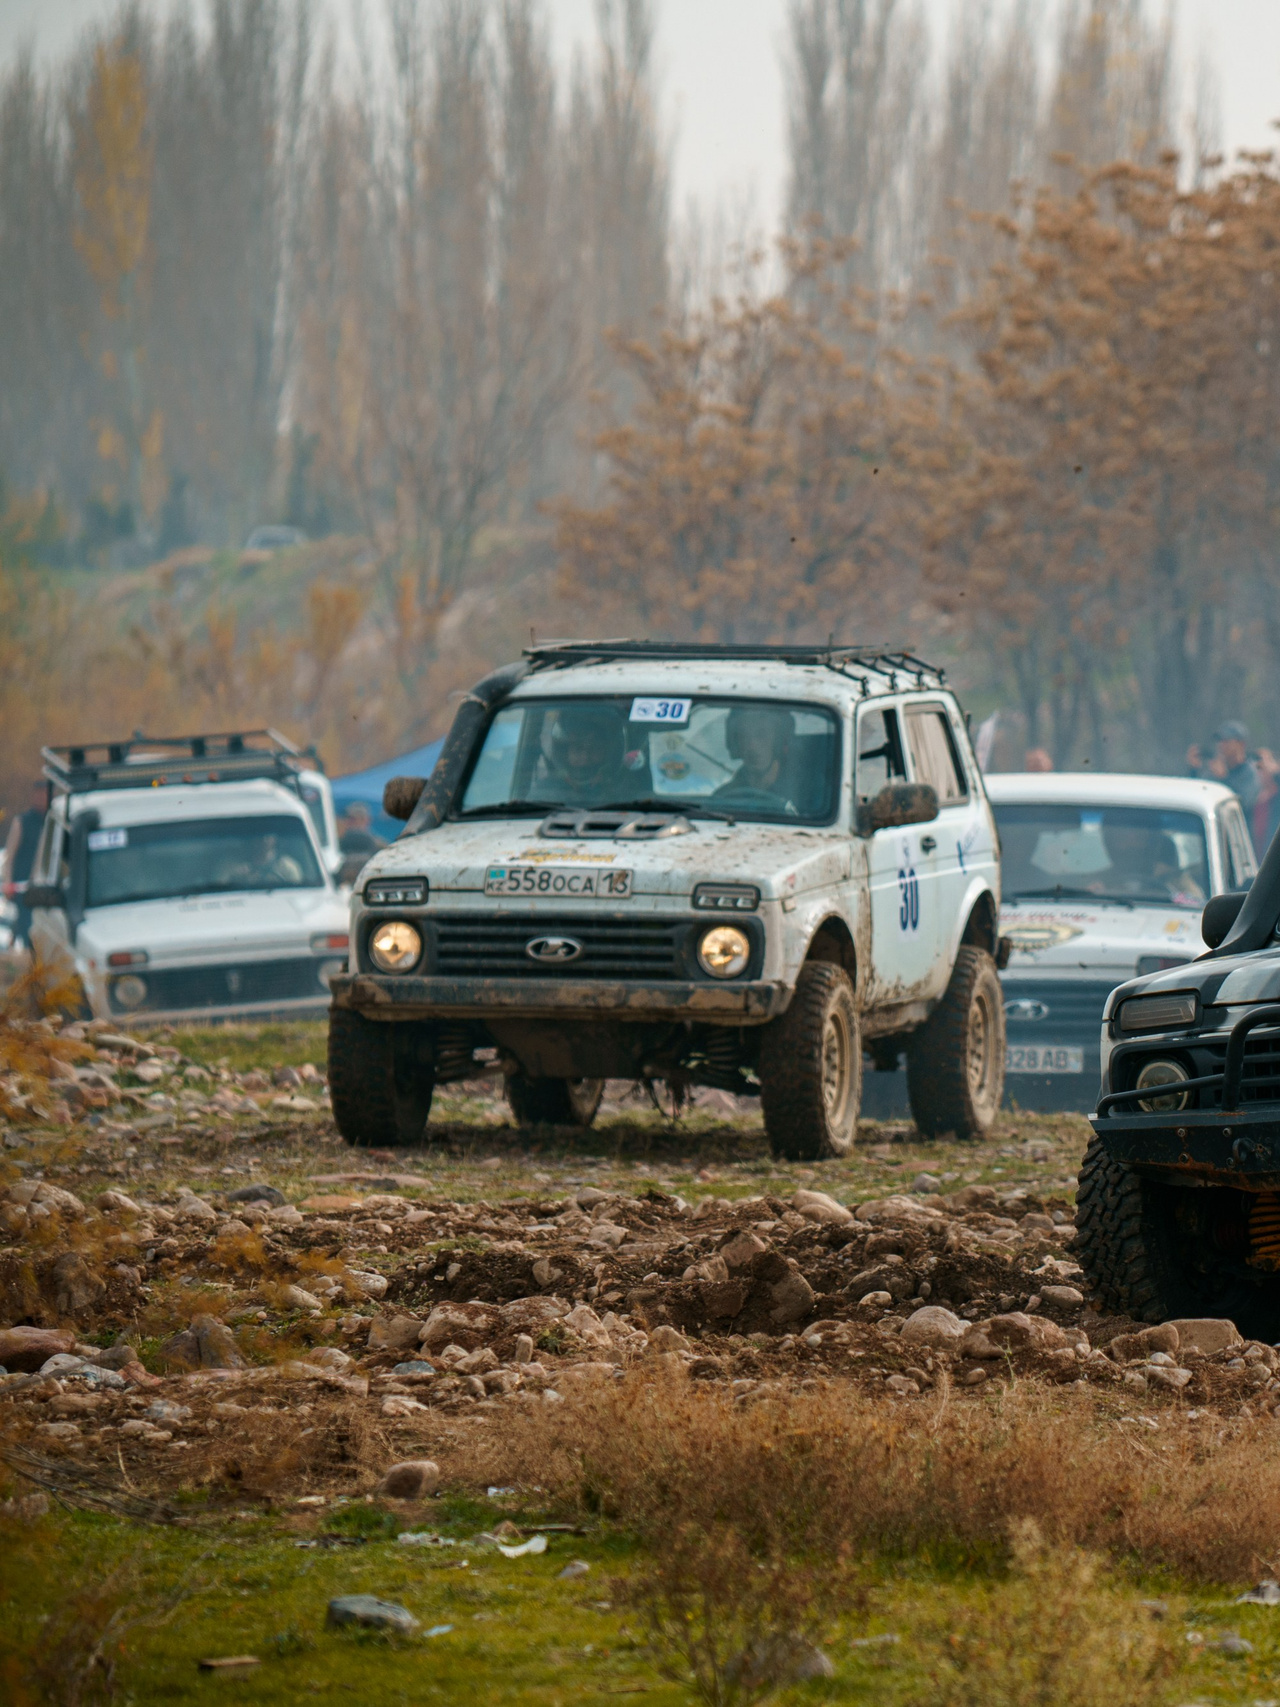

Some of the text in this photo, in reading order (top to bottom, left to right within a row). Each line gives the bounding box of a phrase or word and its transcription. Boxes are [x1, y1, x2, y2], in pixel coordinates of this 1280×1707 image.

[656, 702, 684, 719] 30
[487, 882, 504, 892] KZ
[899, 868, 919, 931] 30
